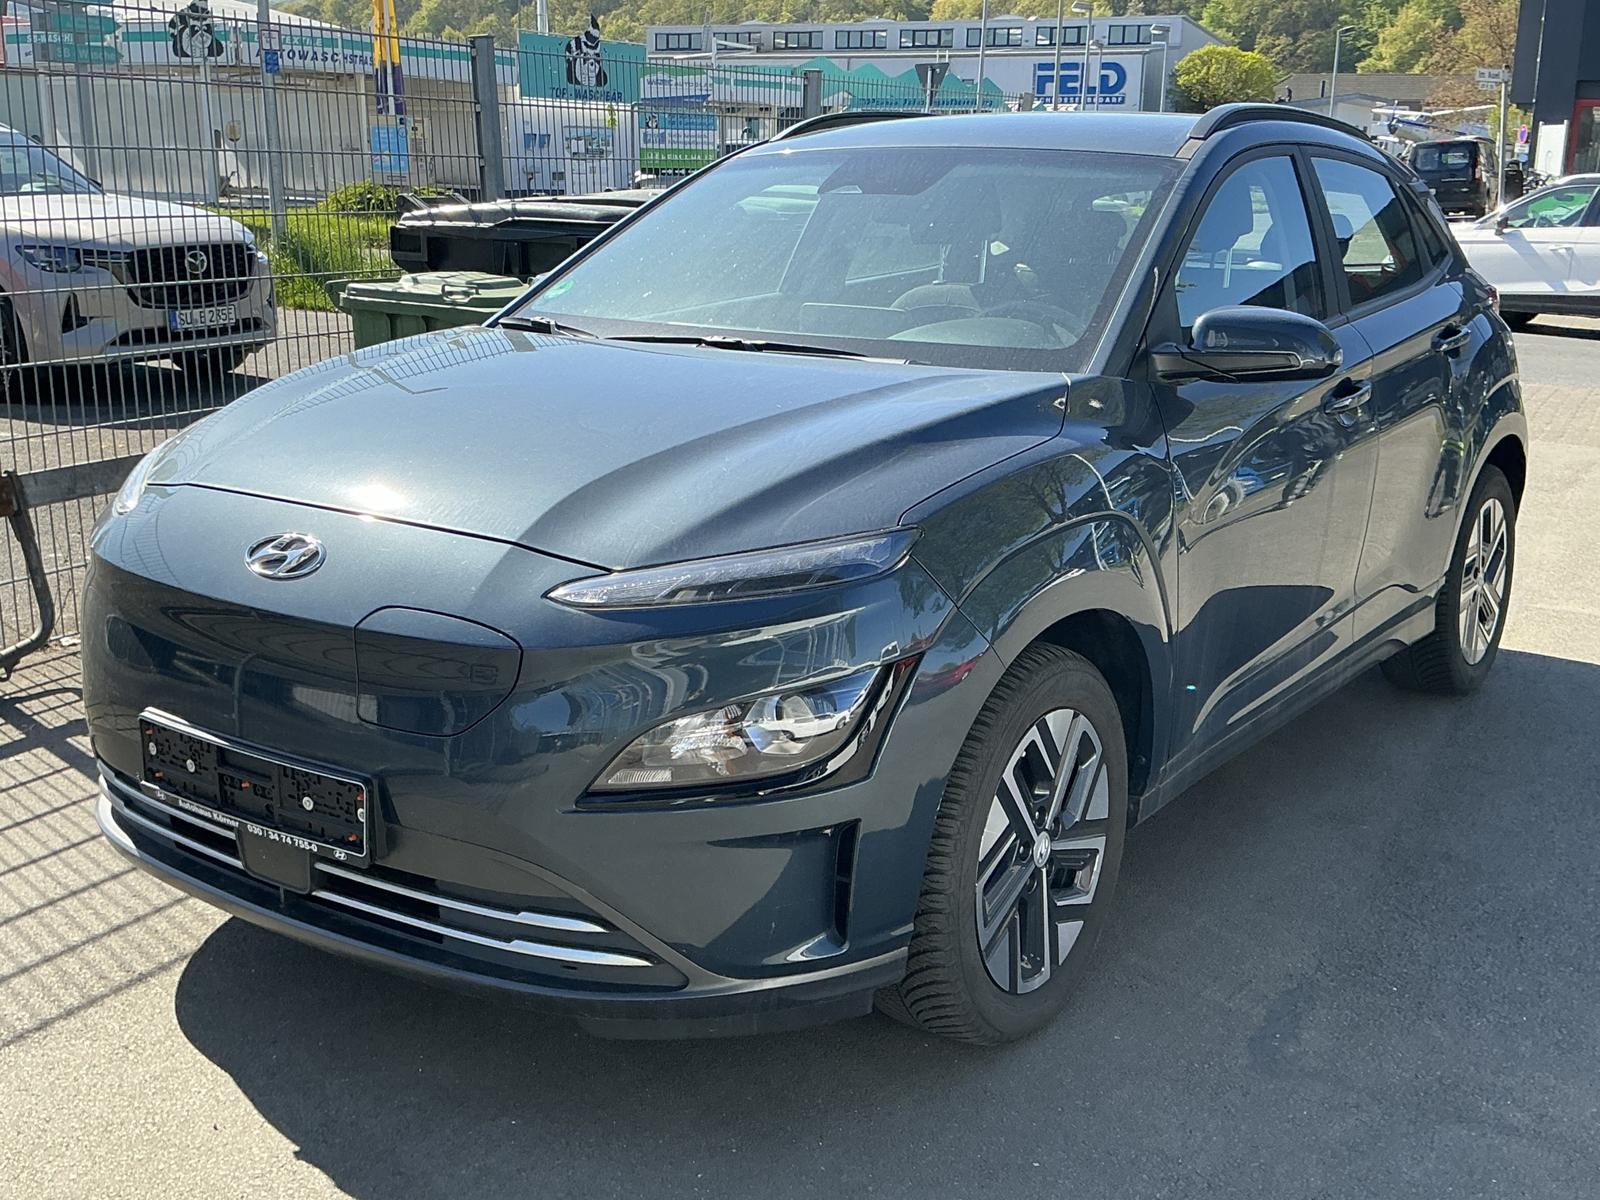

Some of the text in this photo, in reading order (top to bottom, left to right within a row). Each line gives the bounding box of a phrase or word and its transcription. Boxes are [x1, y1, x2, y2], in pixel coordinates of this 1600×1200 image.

[255, 48, 373, 66] ATOWASCHSTRAS
[1036, 62, 1127, 95] FELD
[247, 824, 263, 836] 030
[268, 831, 280, 841] 34
[280, 834, 292, 845] 74
[293, 836, 318, 852] 755-0
